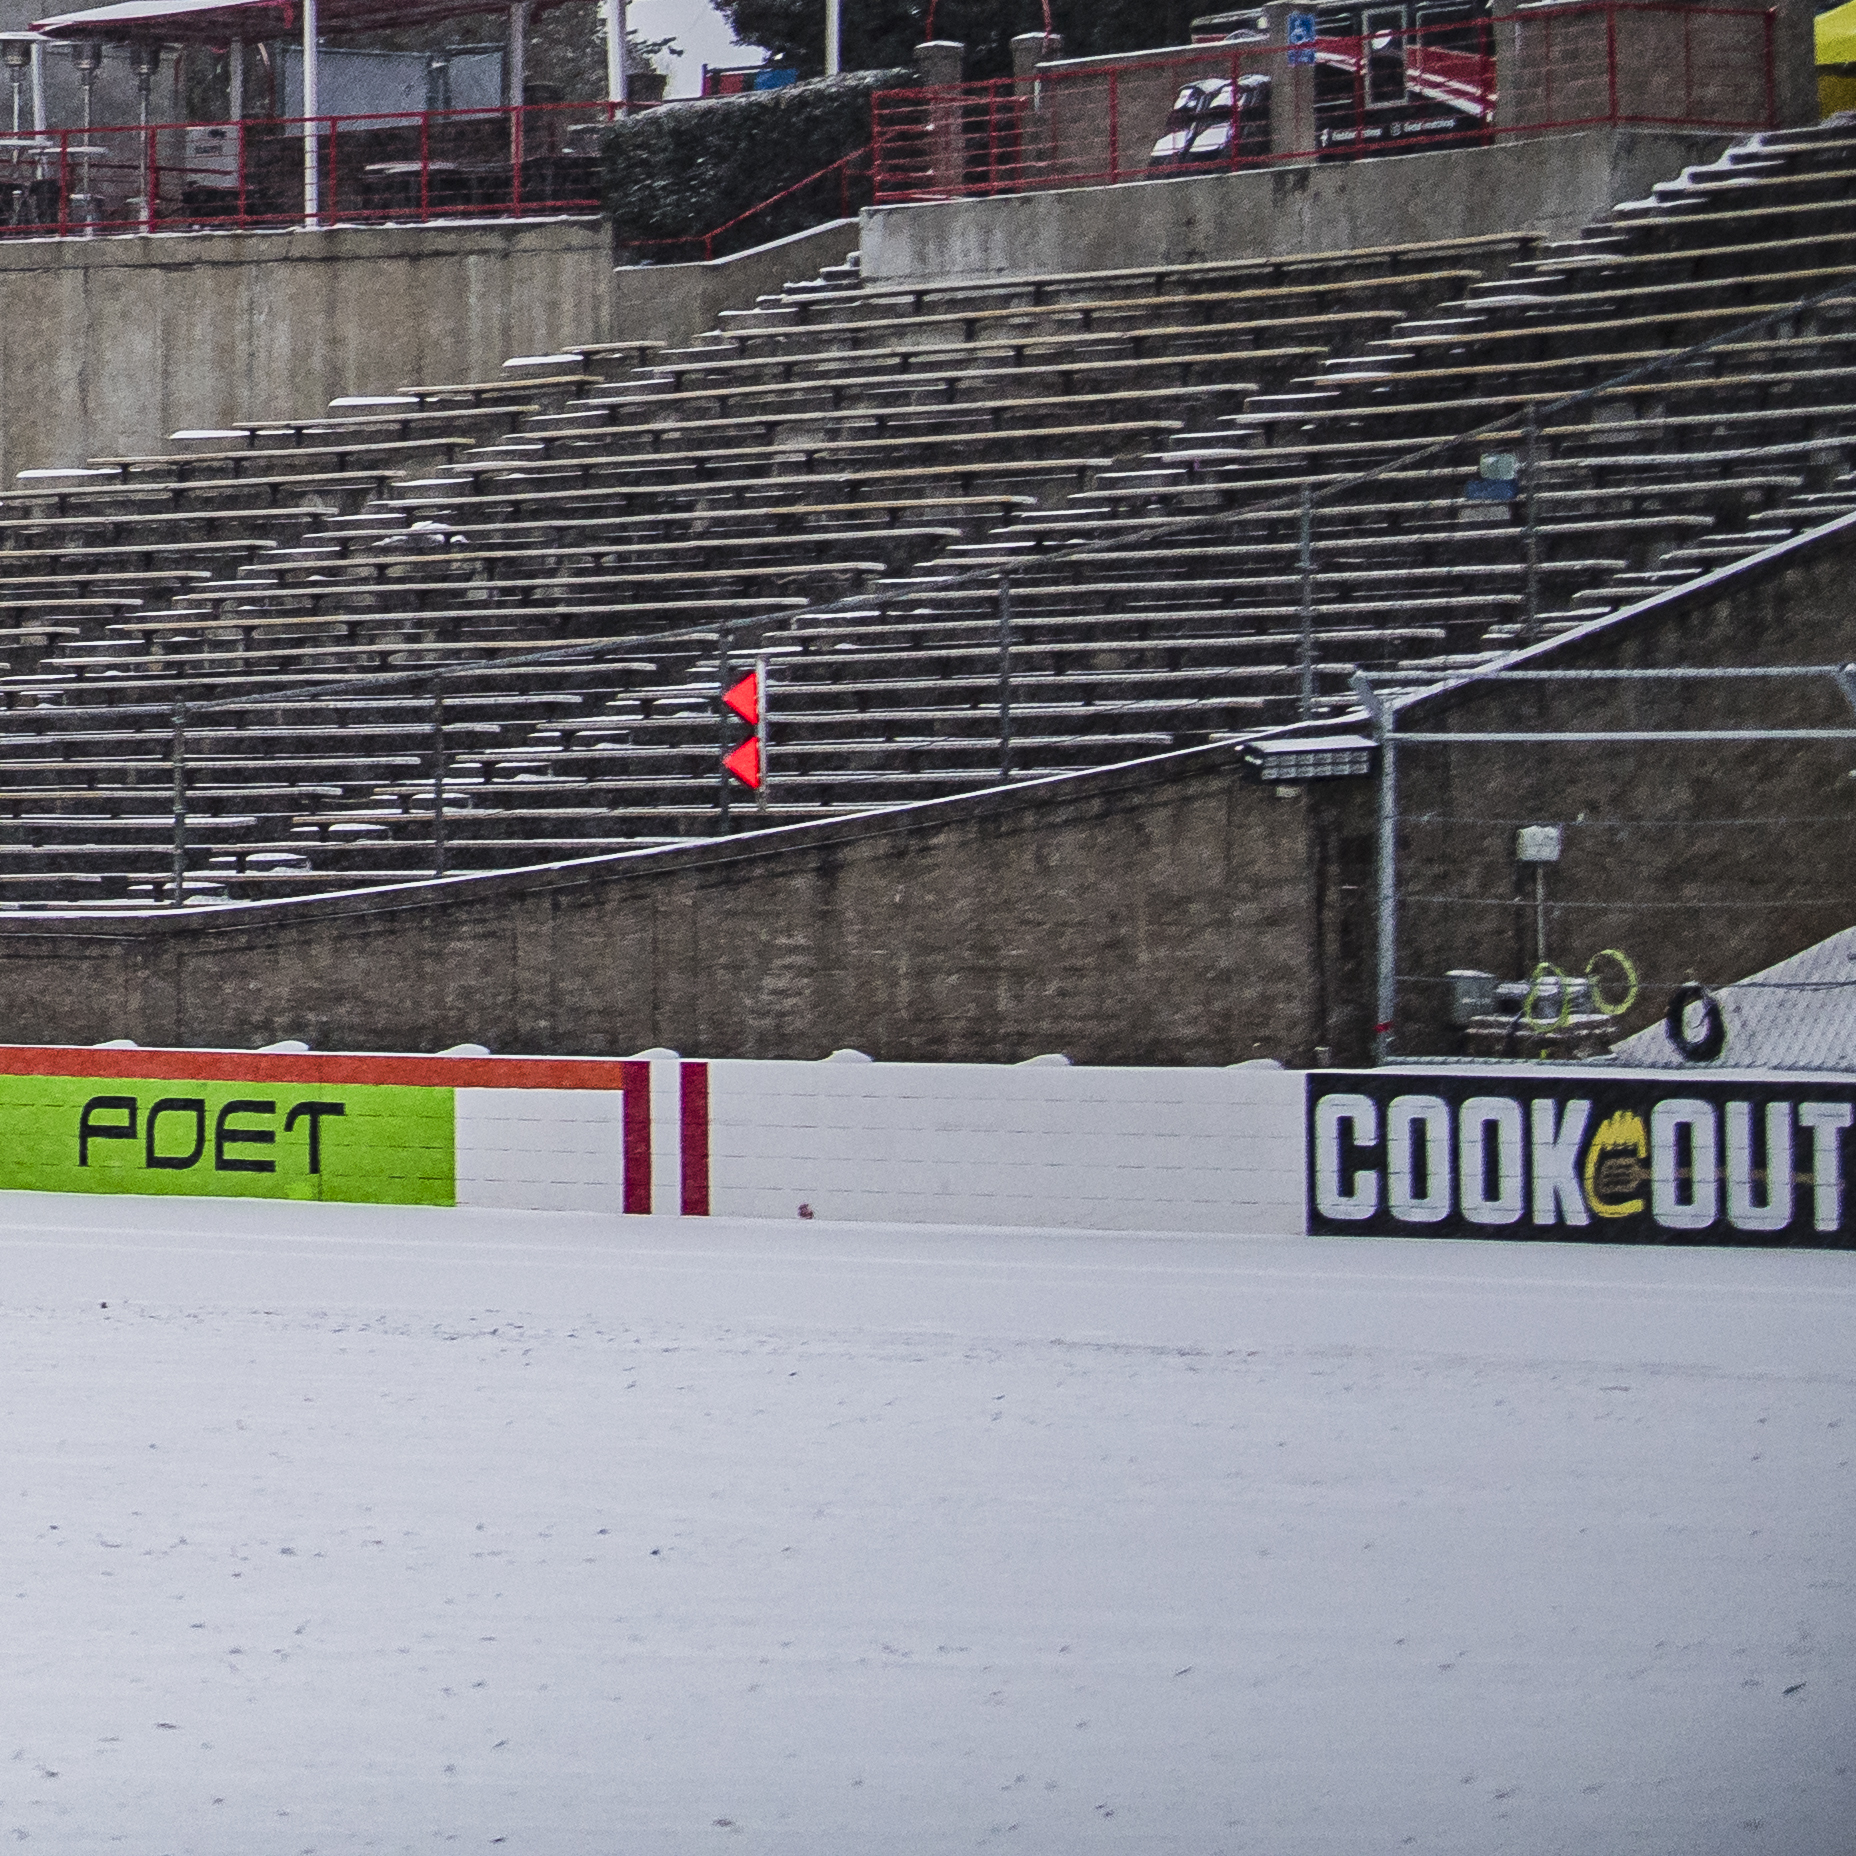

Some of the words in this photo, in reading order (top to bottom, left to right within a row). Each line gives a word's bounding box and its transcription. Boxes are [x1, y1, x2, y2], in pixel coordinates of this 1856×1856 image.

[78, 1094, 346, 1175] POET
[1314, 1093, 1591, 1226] COOK
[1650, 1098, 1854, 1232] OUT
